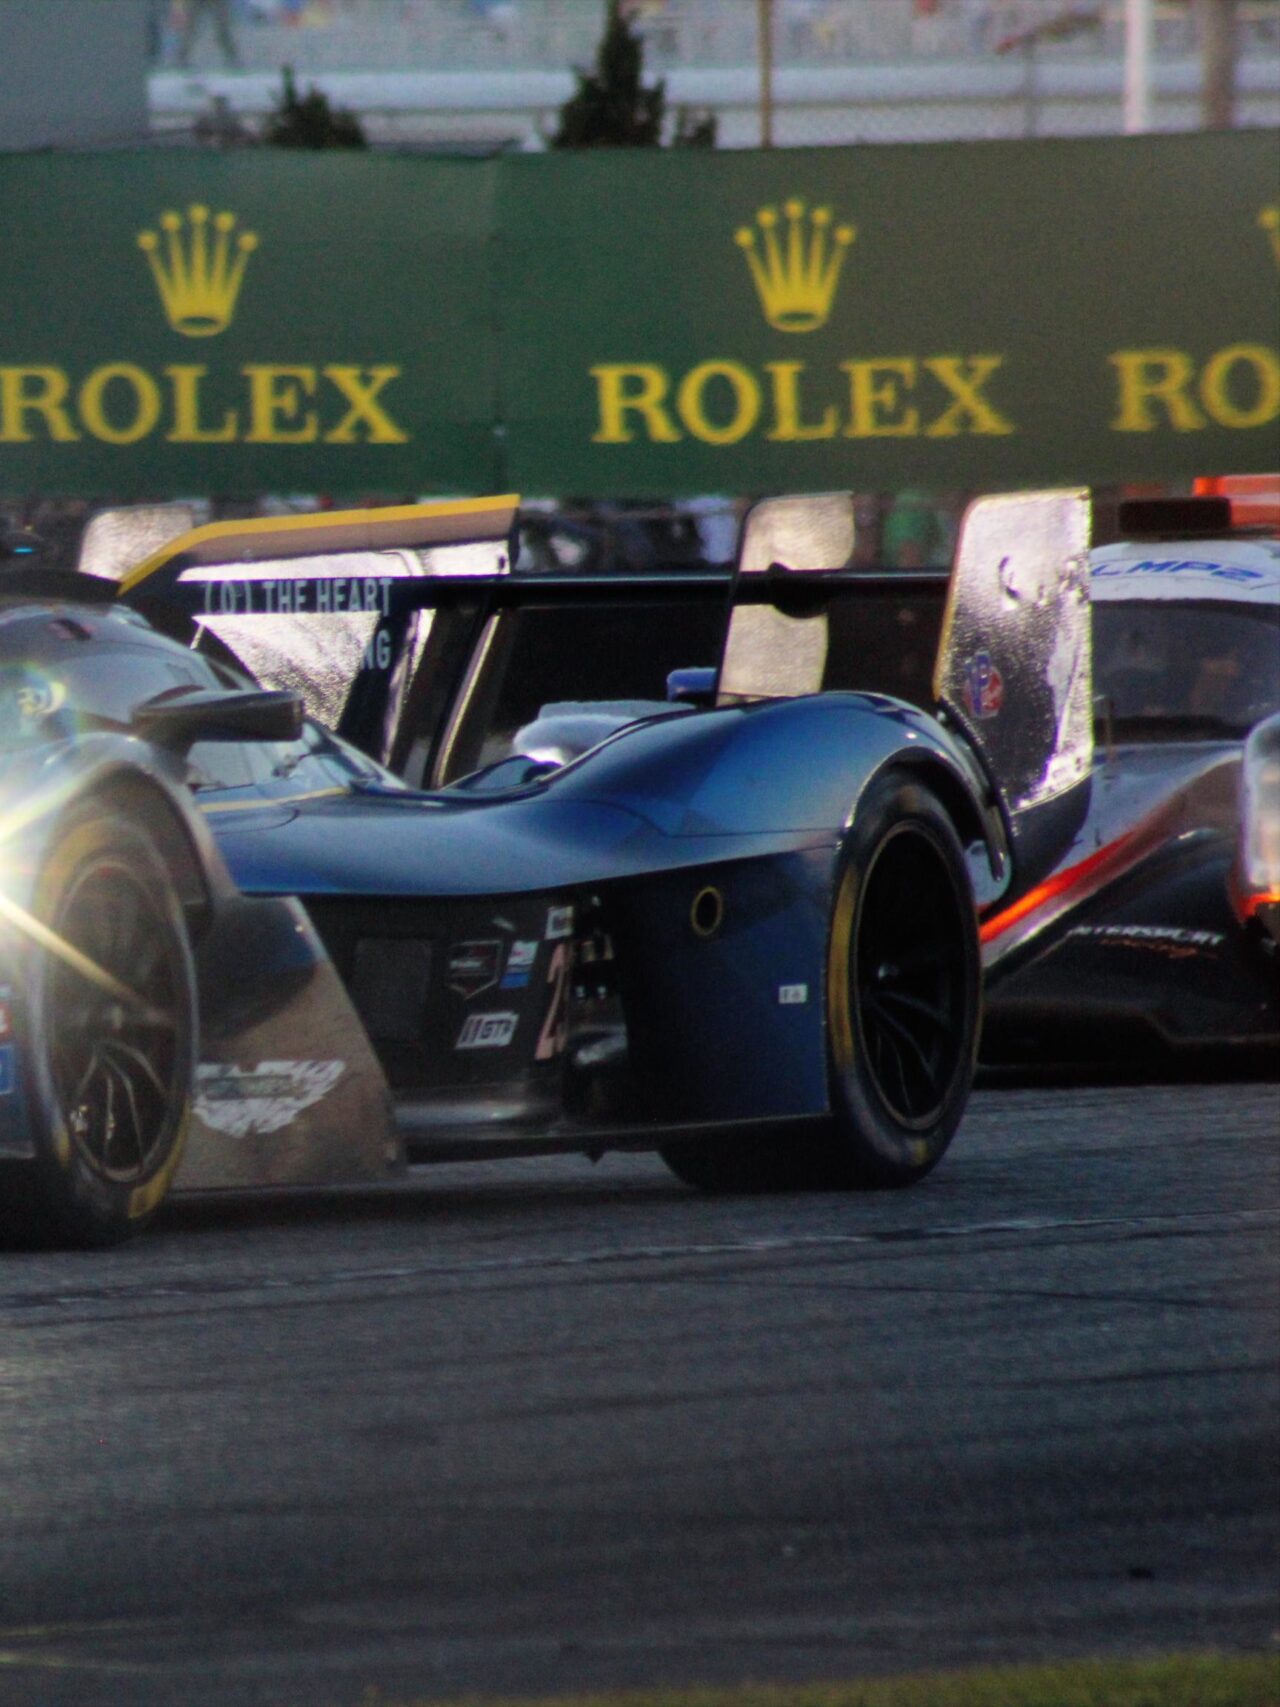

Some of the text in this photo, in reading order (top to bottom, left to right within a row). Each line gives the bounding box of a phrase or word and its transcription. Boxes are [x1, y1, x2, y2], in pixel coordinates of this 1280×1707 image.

[591, 354, 1015, 446] ROLEX
[1091, 559, 1264, 583] LMP2
[261, 579, 308, 613] THE
[316, 577, 394, 616] HEART
